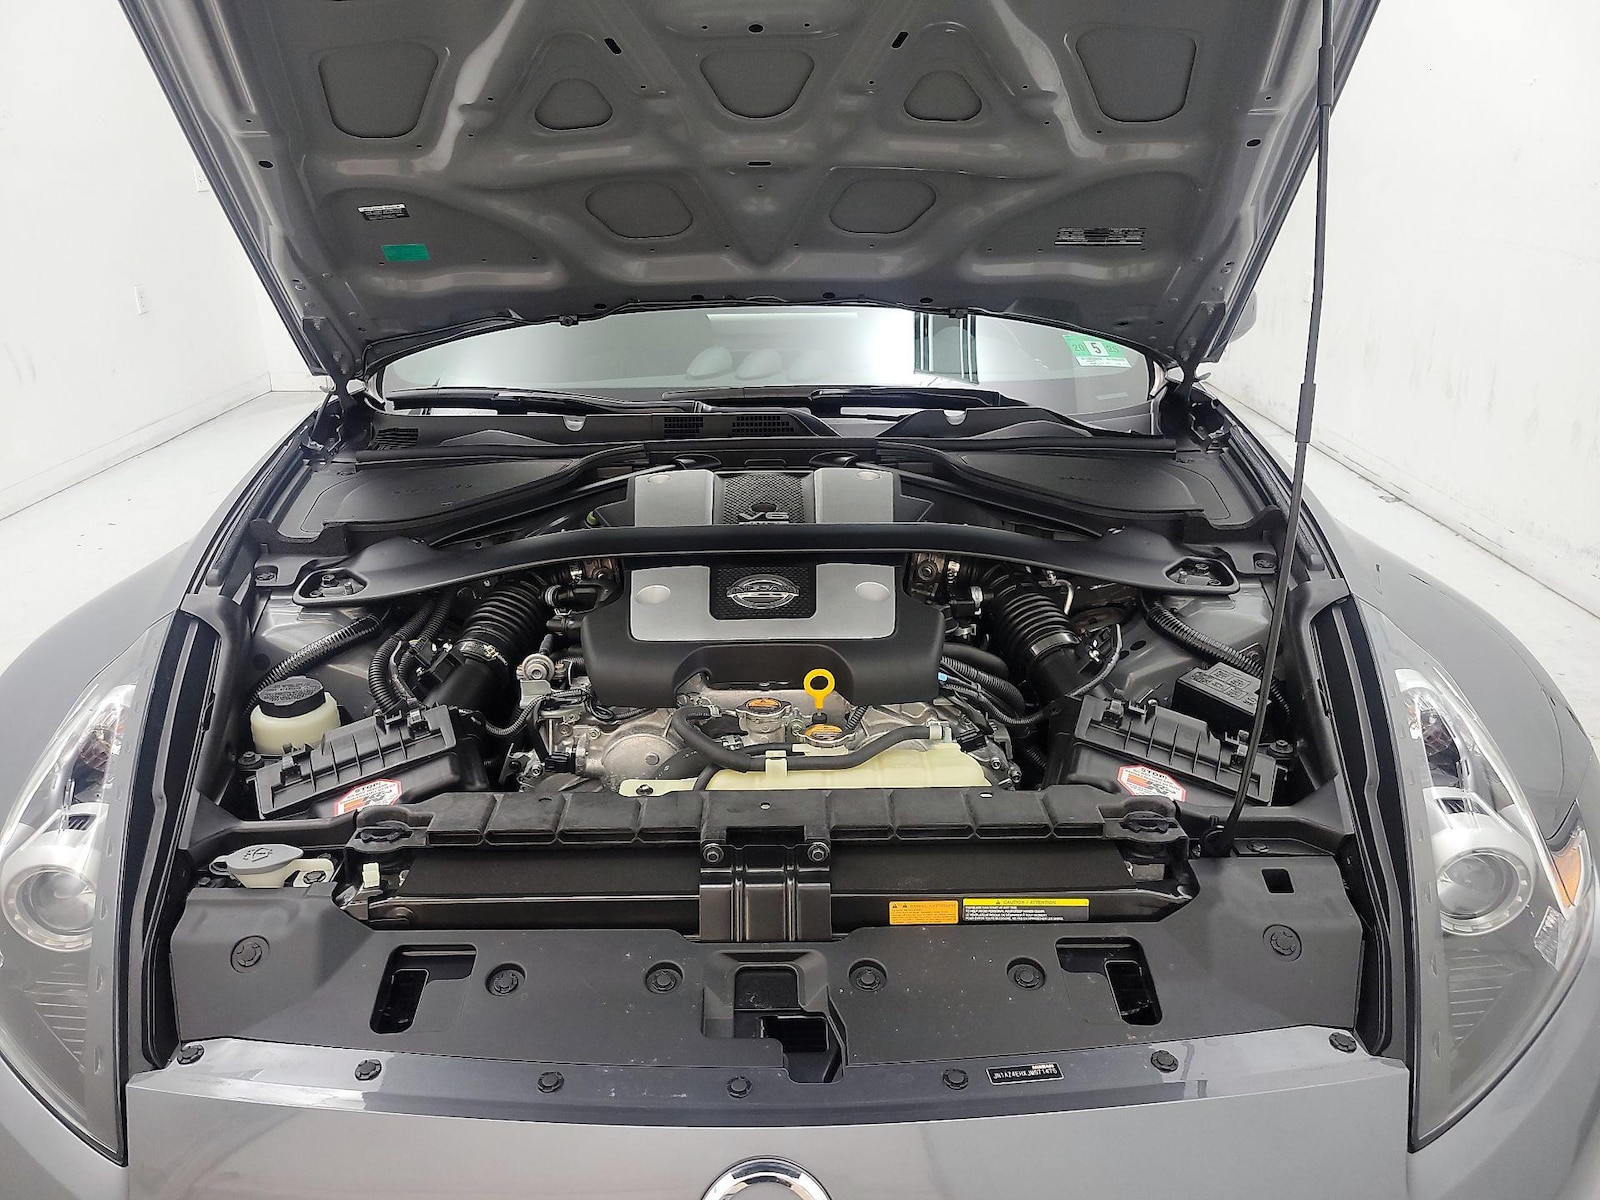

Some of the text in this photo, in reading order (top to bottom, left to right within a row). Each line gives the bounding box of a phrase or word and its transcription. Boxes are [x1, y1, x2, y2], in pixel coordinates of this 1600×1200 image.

[1072, 344, 1085, 352] 20
[1091, 342, 1102, 354] 5
[739, 511, 789, 520] V6
